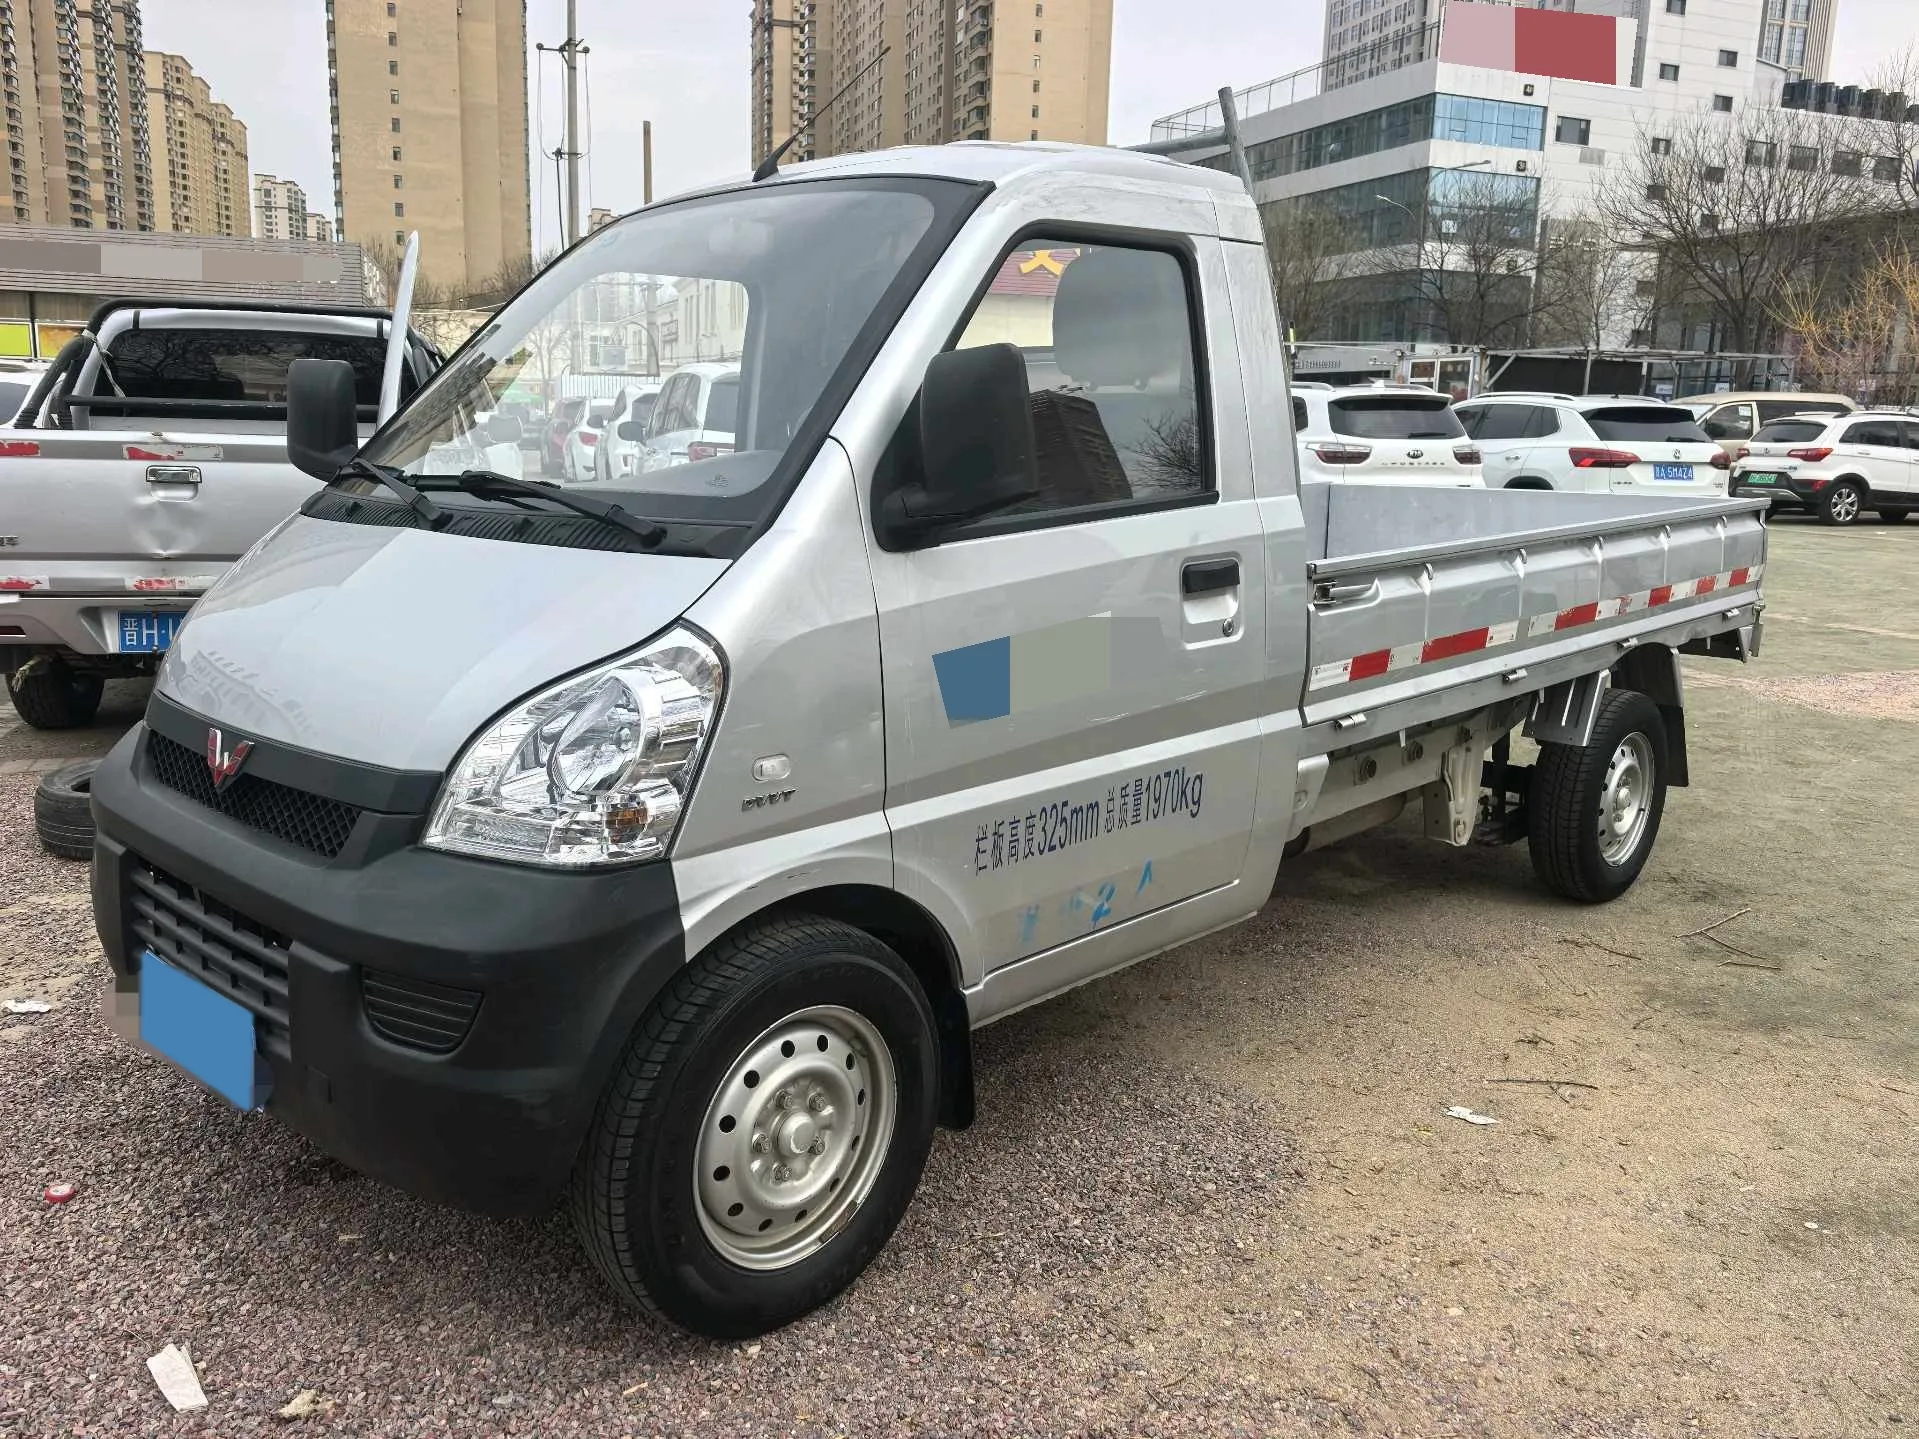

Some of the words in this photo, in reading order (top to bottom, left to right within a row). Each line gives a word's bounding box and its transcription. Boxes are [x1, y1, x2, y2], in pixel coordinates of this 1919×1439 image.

[974, 799, 1100, 876] 栏板高度325mm
[1104, 766, 1204, 834] 总质量1970kg
